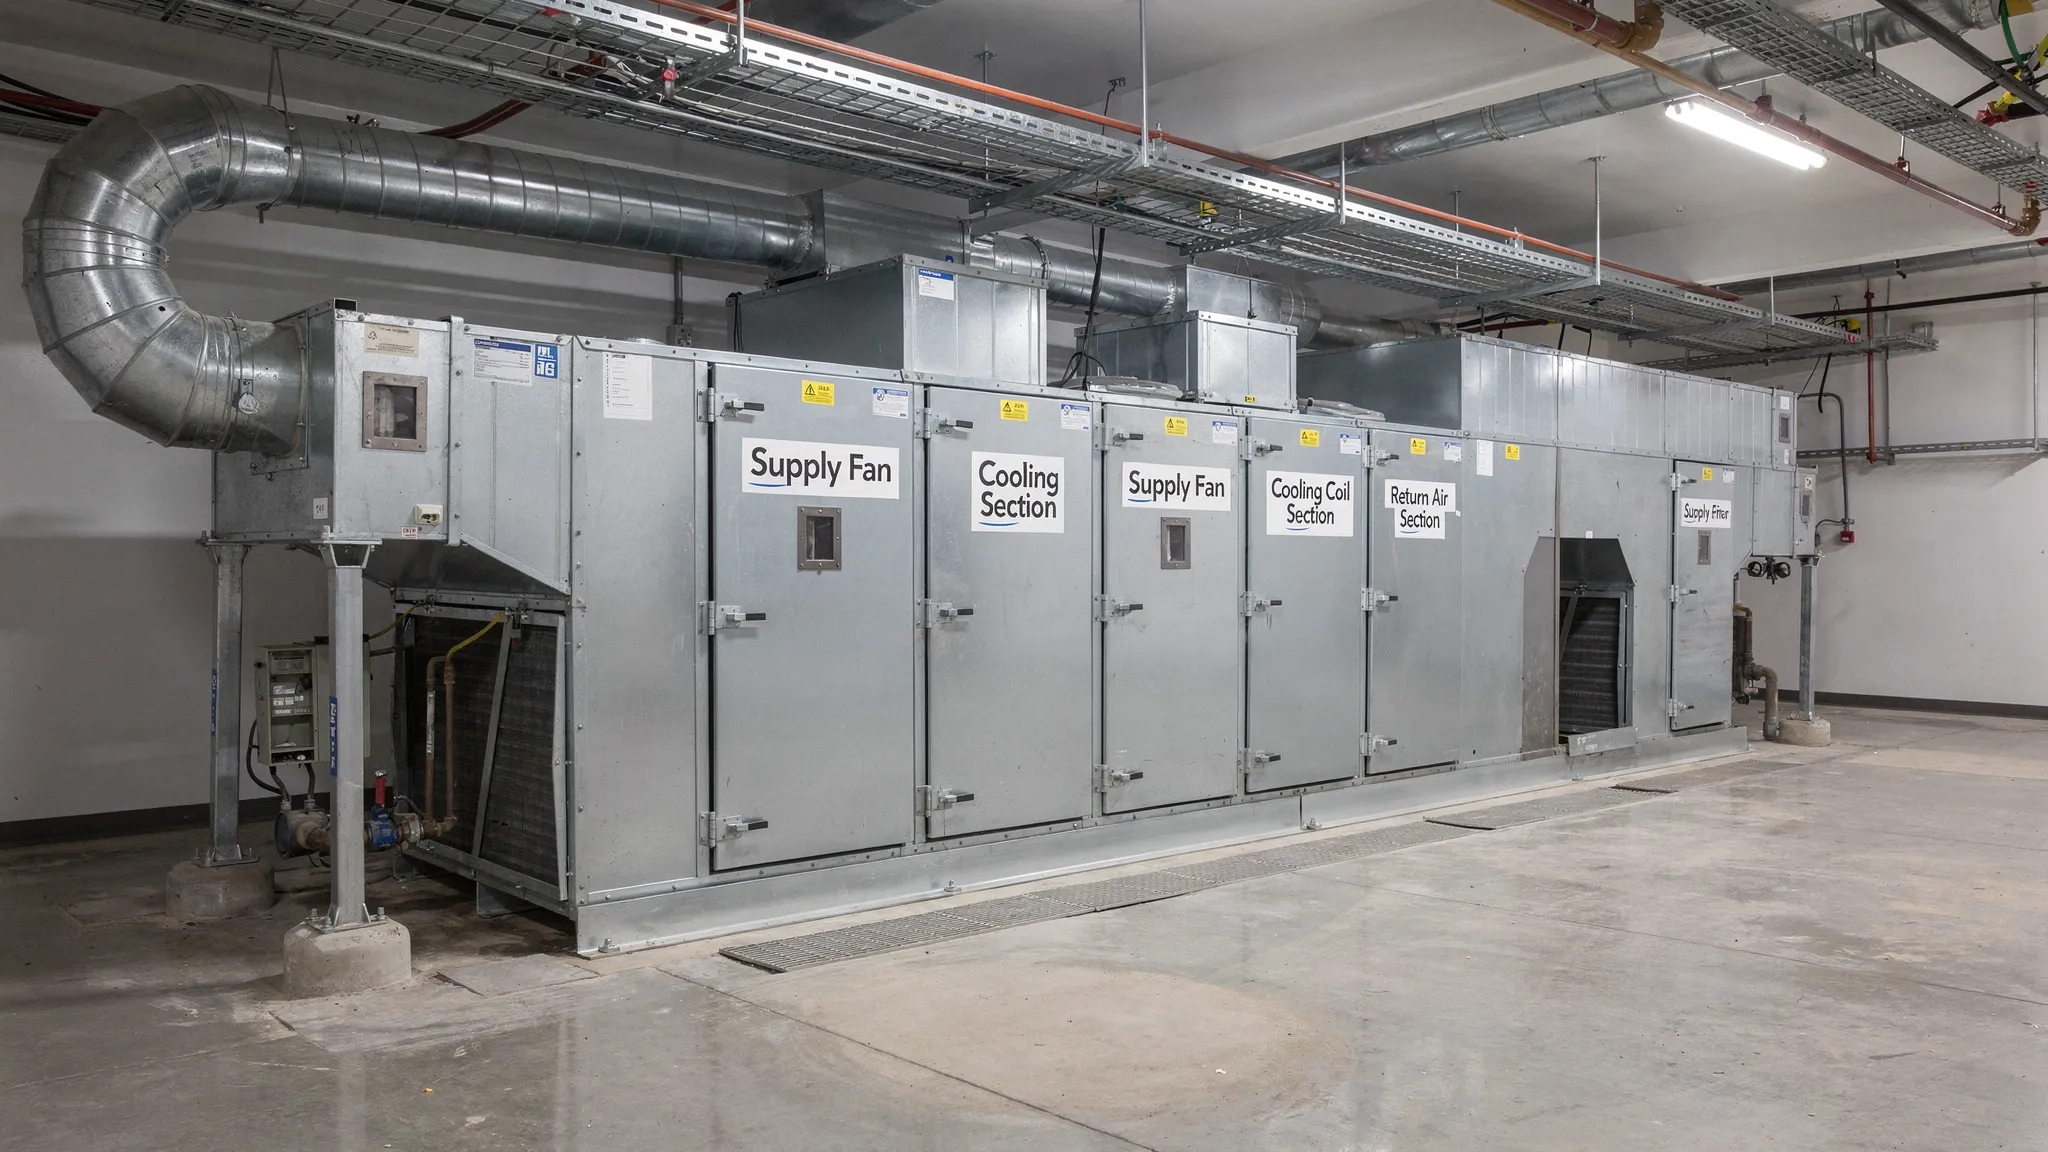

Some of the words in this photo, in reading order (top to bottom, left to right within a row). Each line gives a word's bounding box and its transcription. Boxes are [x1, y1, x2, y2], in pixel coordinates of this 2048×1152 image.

[750, 446, 842, 488] Supply
[849, 453, 892, 483] Fan
[978, 459, 1059, 497] Cooling
[1128, 470, 1191, 503] Supply
[1195, 474, 1225, 498] Fan
[1271, 477, 1323, 506] Cooling
[1325, 480, 1350, 502] Coil
[1391, 485, 1429, 506] Return
[1431, 488, 1449, 506] Air
[980, 490, 1057, 519] Section
[1287, 503, 1335, 525] Section
[1399, 508, 1440, 529] Section
